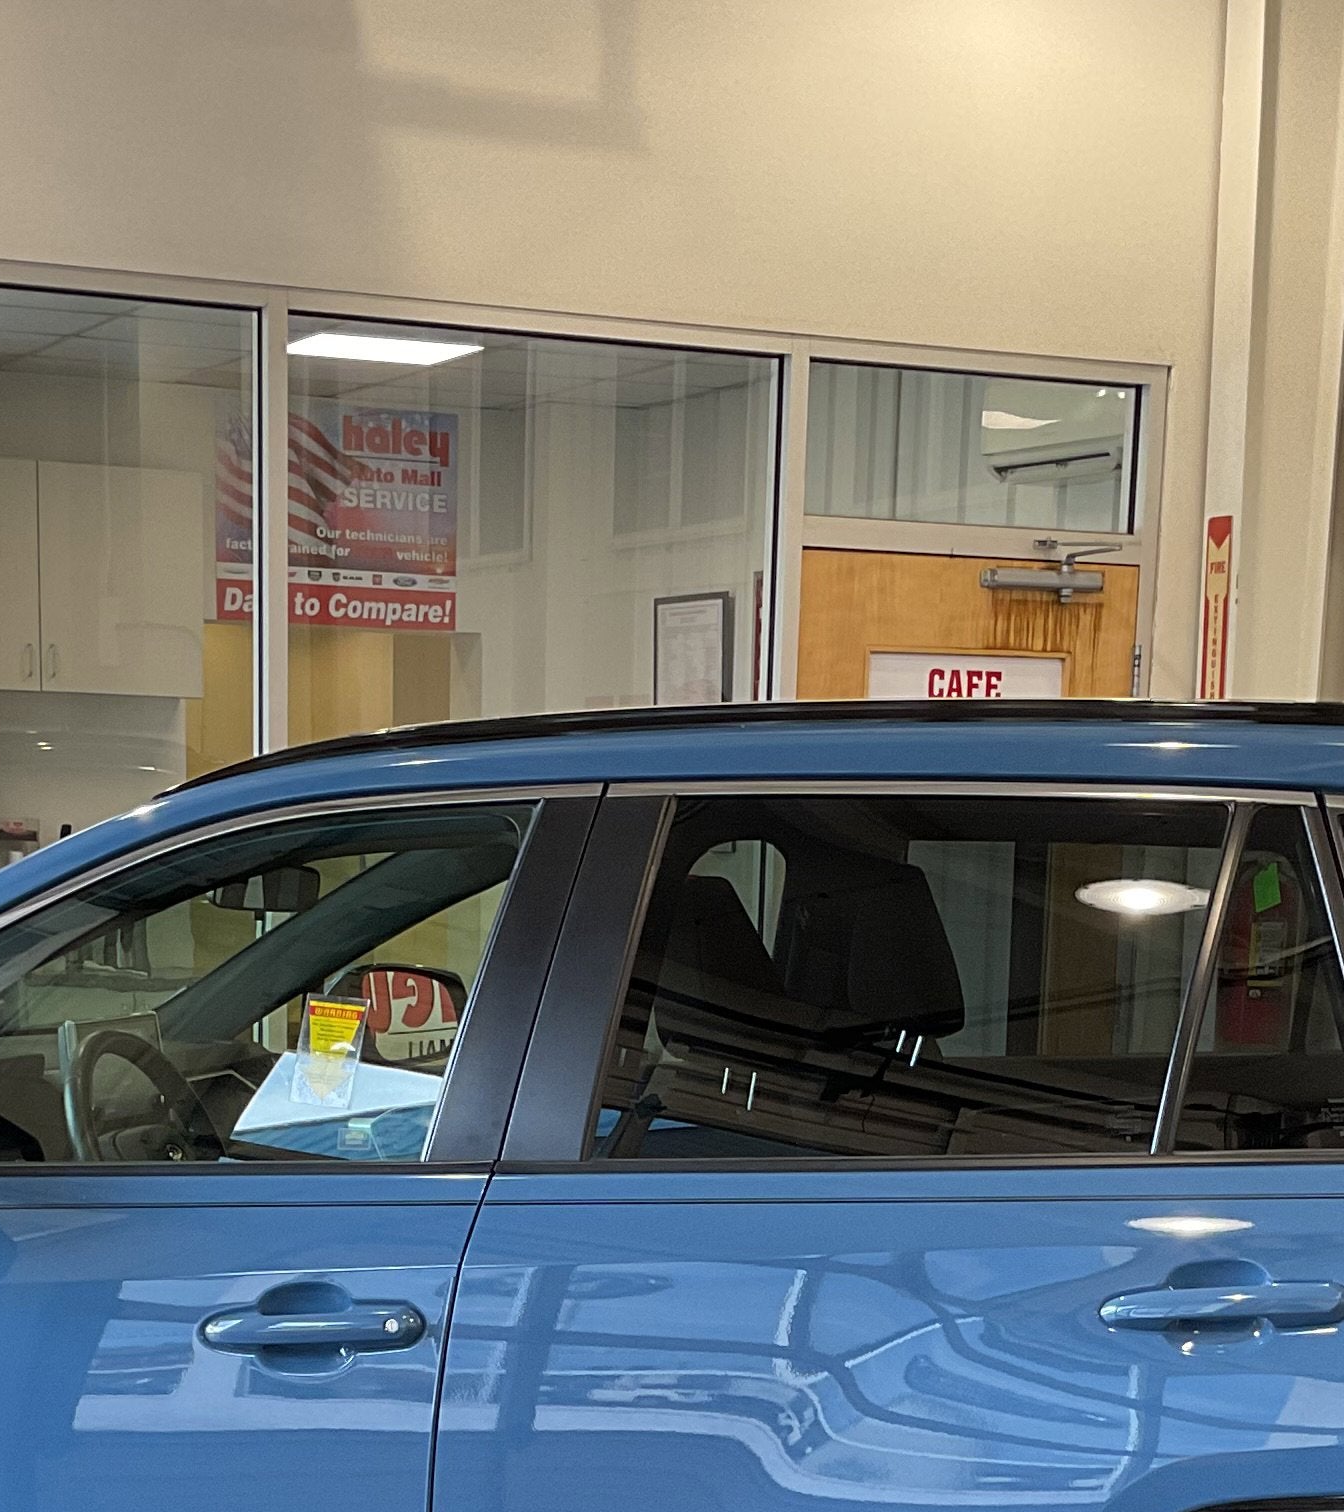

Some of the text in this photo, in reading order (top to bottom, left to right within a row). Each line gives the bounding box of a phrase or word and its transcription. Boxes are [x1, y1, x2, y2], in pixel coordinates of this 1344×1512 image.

[342, 415, 450, 467] haley
[353, 468, 442, 487] Auto Mall
[342, 487, 448, 513] SERVICE
[316, 526, 342, 540] Our
[345, 528, 422, 547] technicians
[332, 544, 351, 557] for
[396, 550, 448, 563] vehicle!
[1209, 561, 1227, 575] FIRE
[294, 592, 321, 617] to
[328, 592, 453, 626] Compare!
